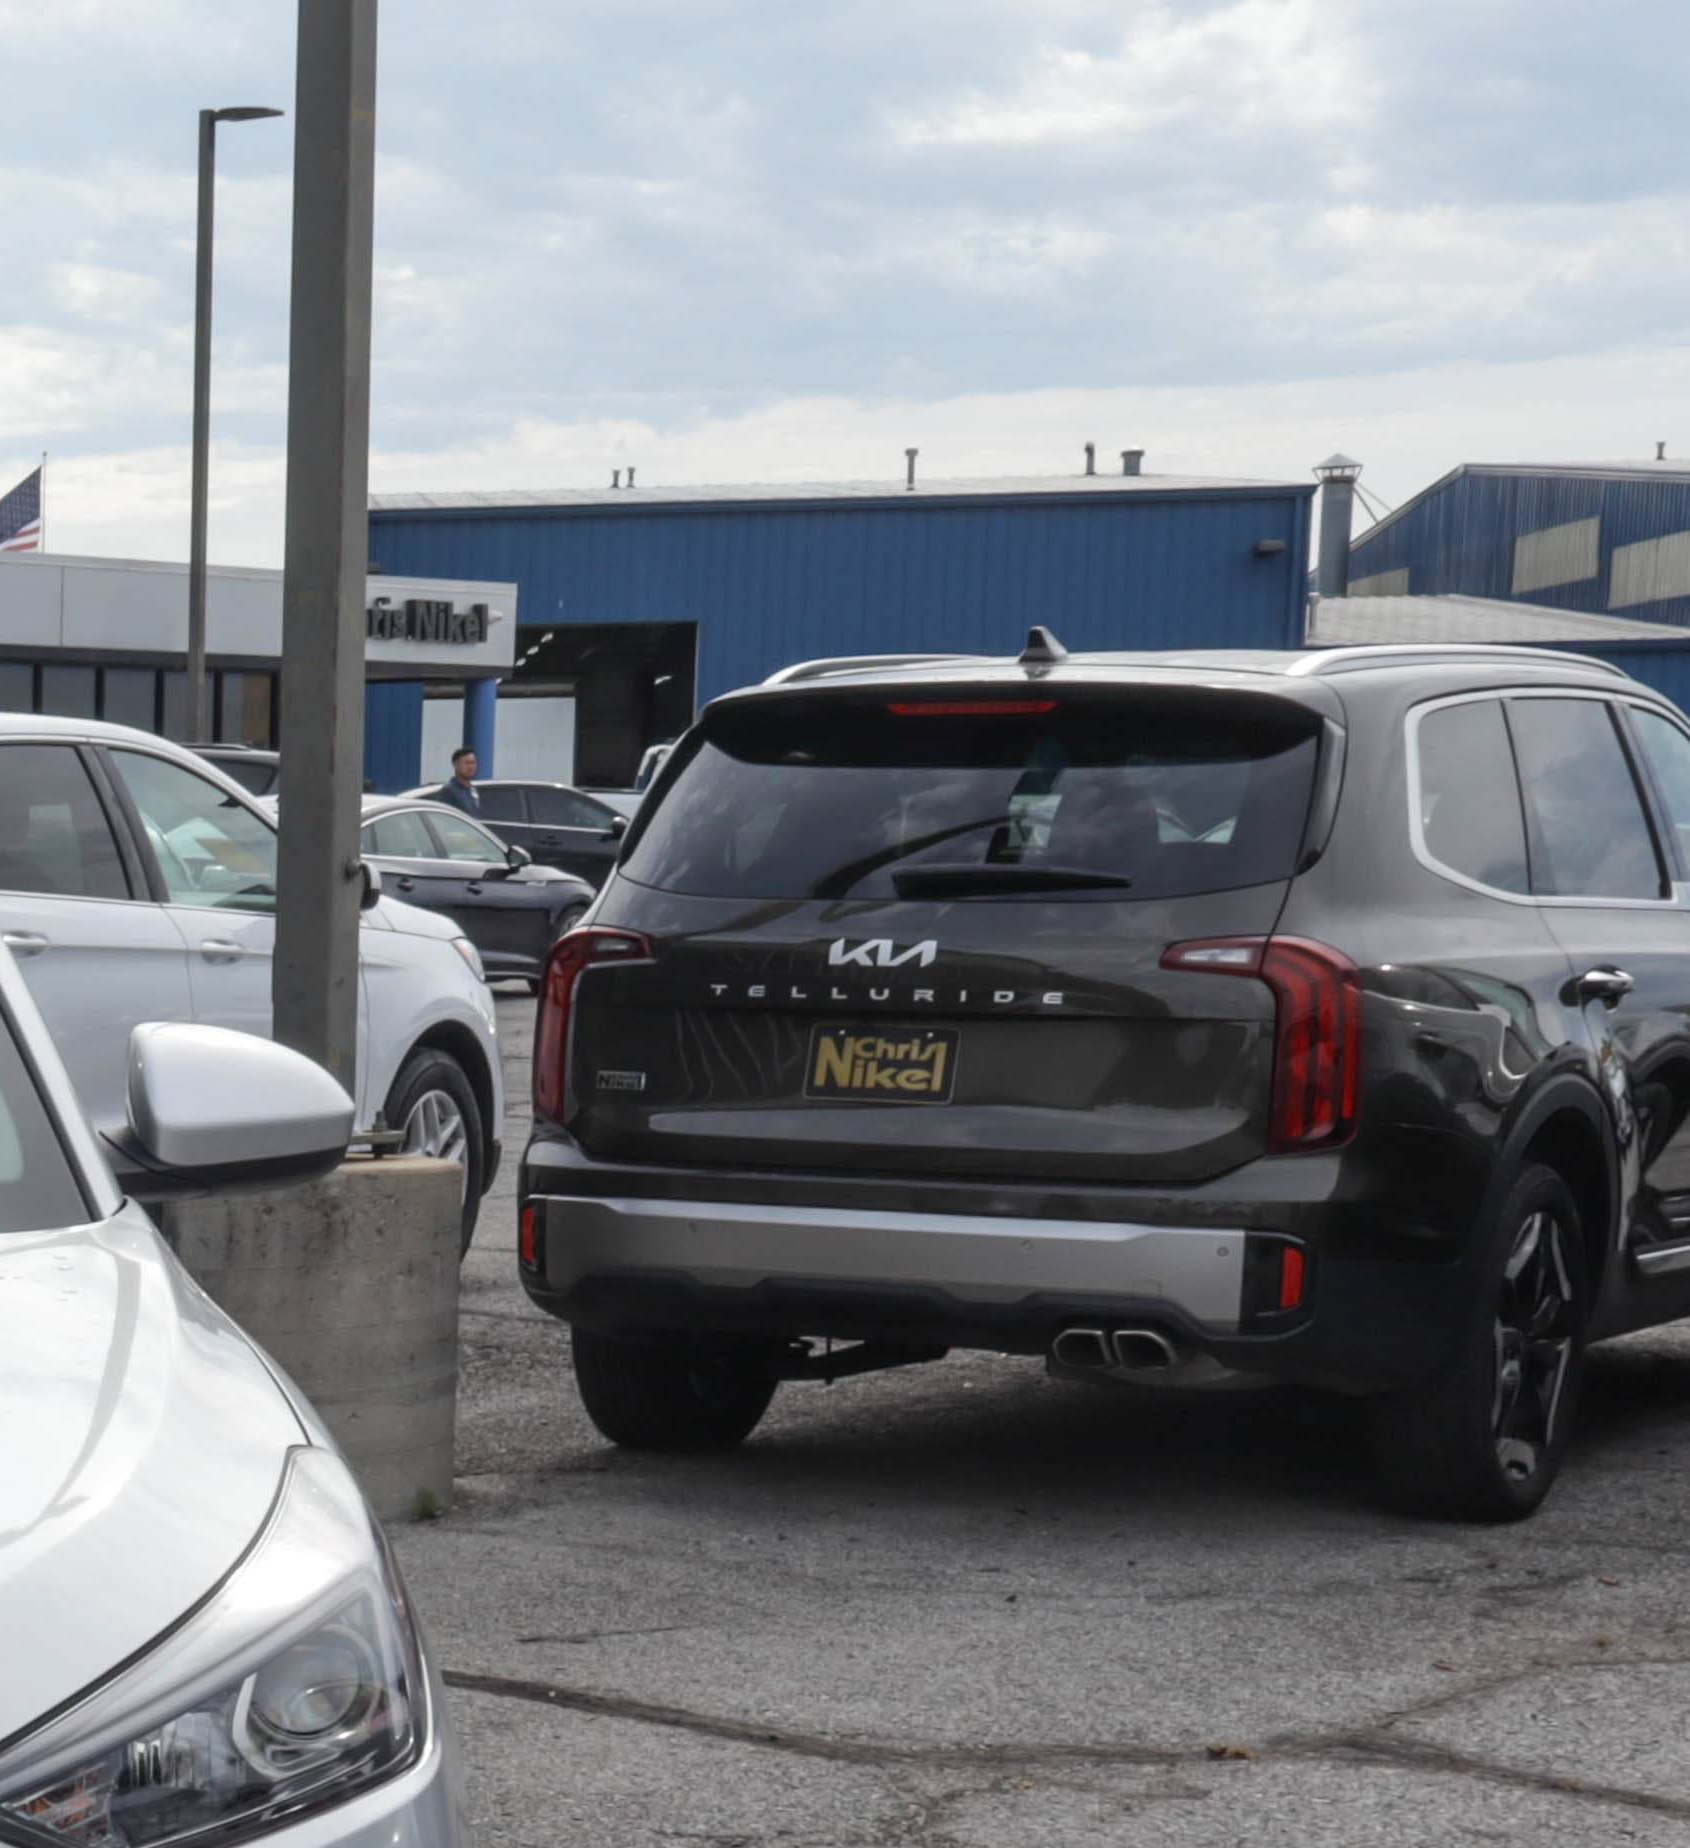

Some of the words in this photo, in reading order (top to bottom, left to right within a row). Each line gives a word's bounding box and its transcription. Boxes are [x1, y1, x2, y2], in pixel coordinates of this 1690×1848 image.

[711, 984, 1063, 1005] TELLURIDE
[854, 1035, 939, 1061] Chris
[813, 1036, 948, 1092] Nikel
